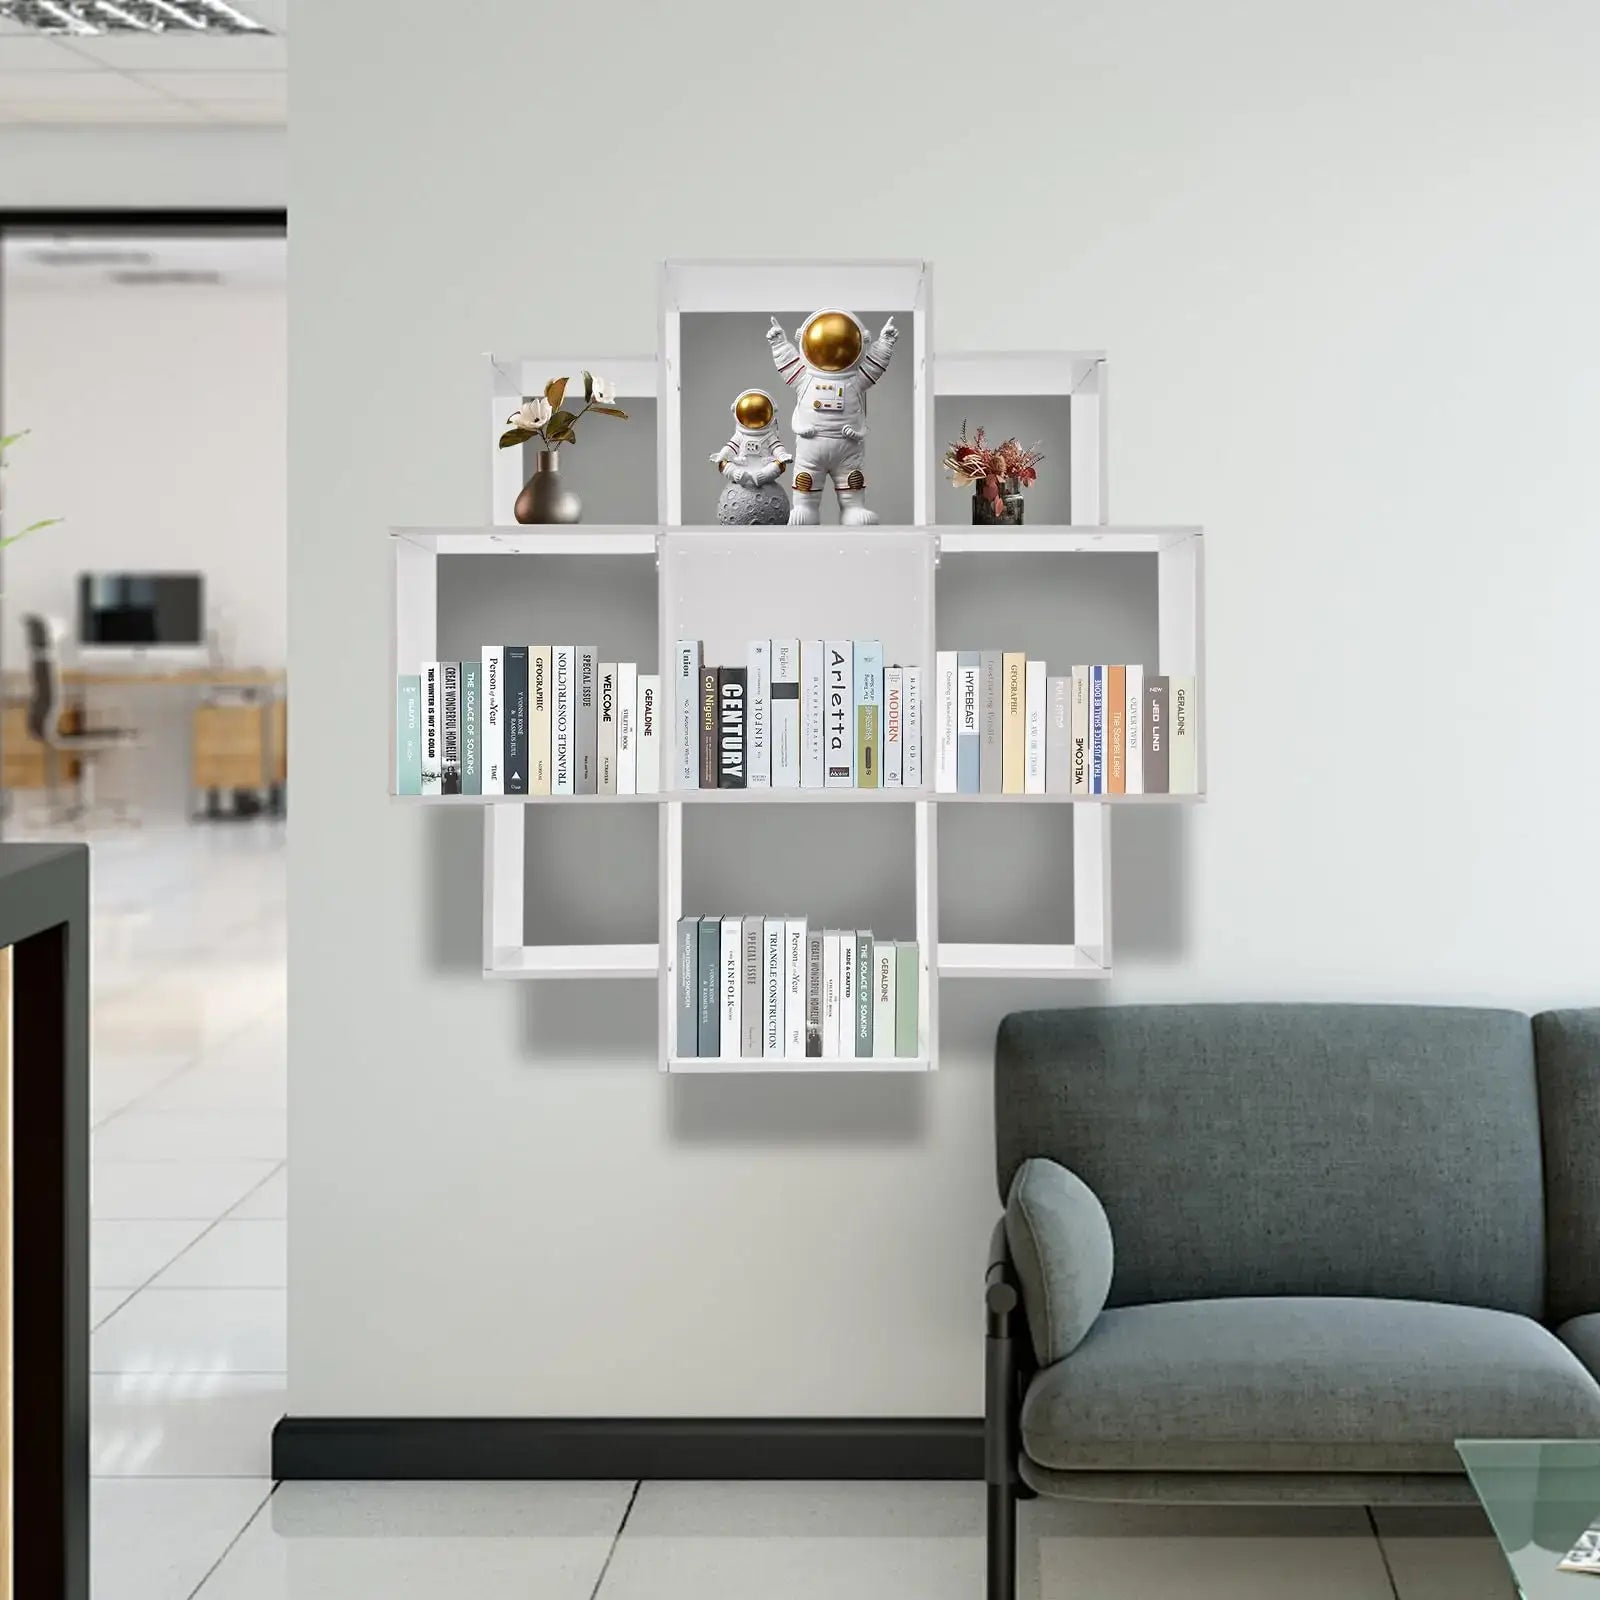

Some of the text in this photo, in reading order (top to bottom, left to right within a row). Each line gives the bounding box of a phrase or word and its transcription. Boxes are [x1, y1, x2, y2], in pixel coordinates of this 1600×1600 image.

[490, 658, 498, 690] Person
[583, 655, 591, 706] SPECIAL ISSUE
[683, 649, 691, 677] Union
[706, 676, 714, 691] Col
[445, 667, 456, 762] CREATE WONDERFUL HOMELIFE
[490, 705, 498, 726] Year
[558, 652, 566, 785] TRIANGLE CONSTRUCTION
[644, 689, 652, 736] GERALDINE
[704, 695, 714, 731] Nigeria
[831, 650, 846, 750] Arletta
[889, 689, 898, 742] MODERN
[965, 671, 974, 729] HYPEBEAST
[428, 729, 434, 737] SO
[467, 725, 474, 735] OF
[722, 684, 743, 777] CENTURY
[747, 932, 756, 984] SPECIAL ISSUE
[810, 941, 819, 1025] CREATE WONDERFUL HOMELIFE
[769, 979, 777, 1048] CONSTRUCTION
[860, 992, 867, 1002] OF
